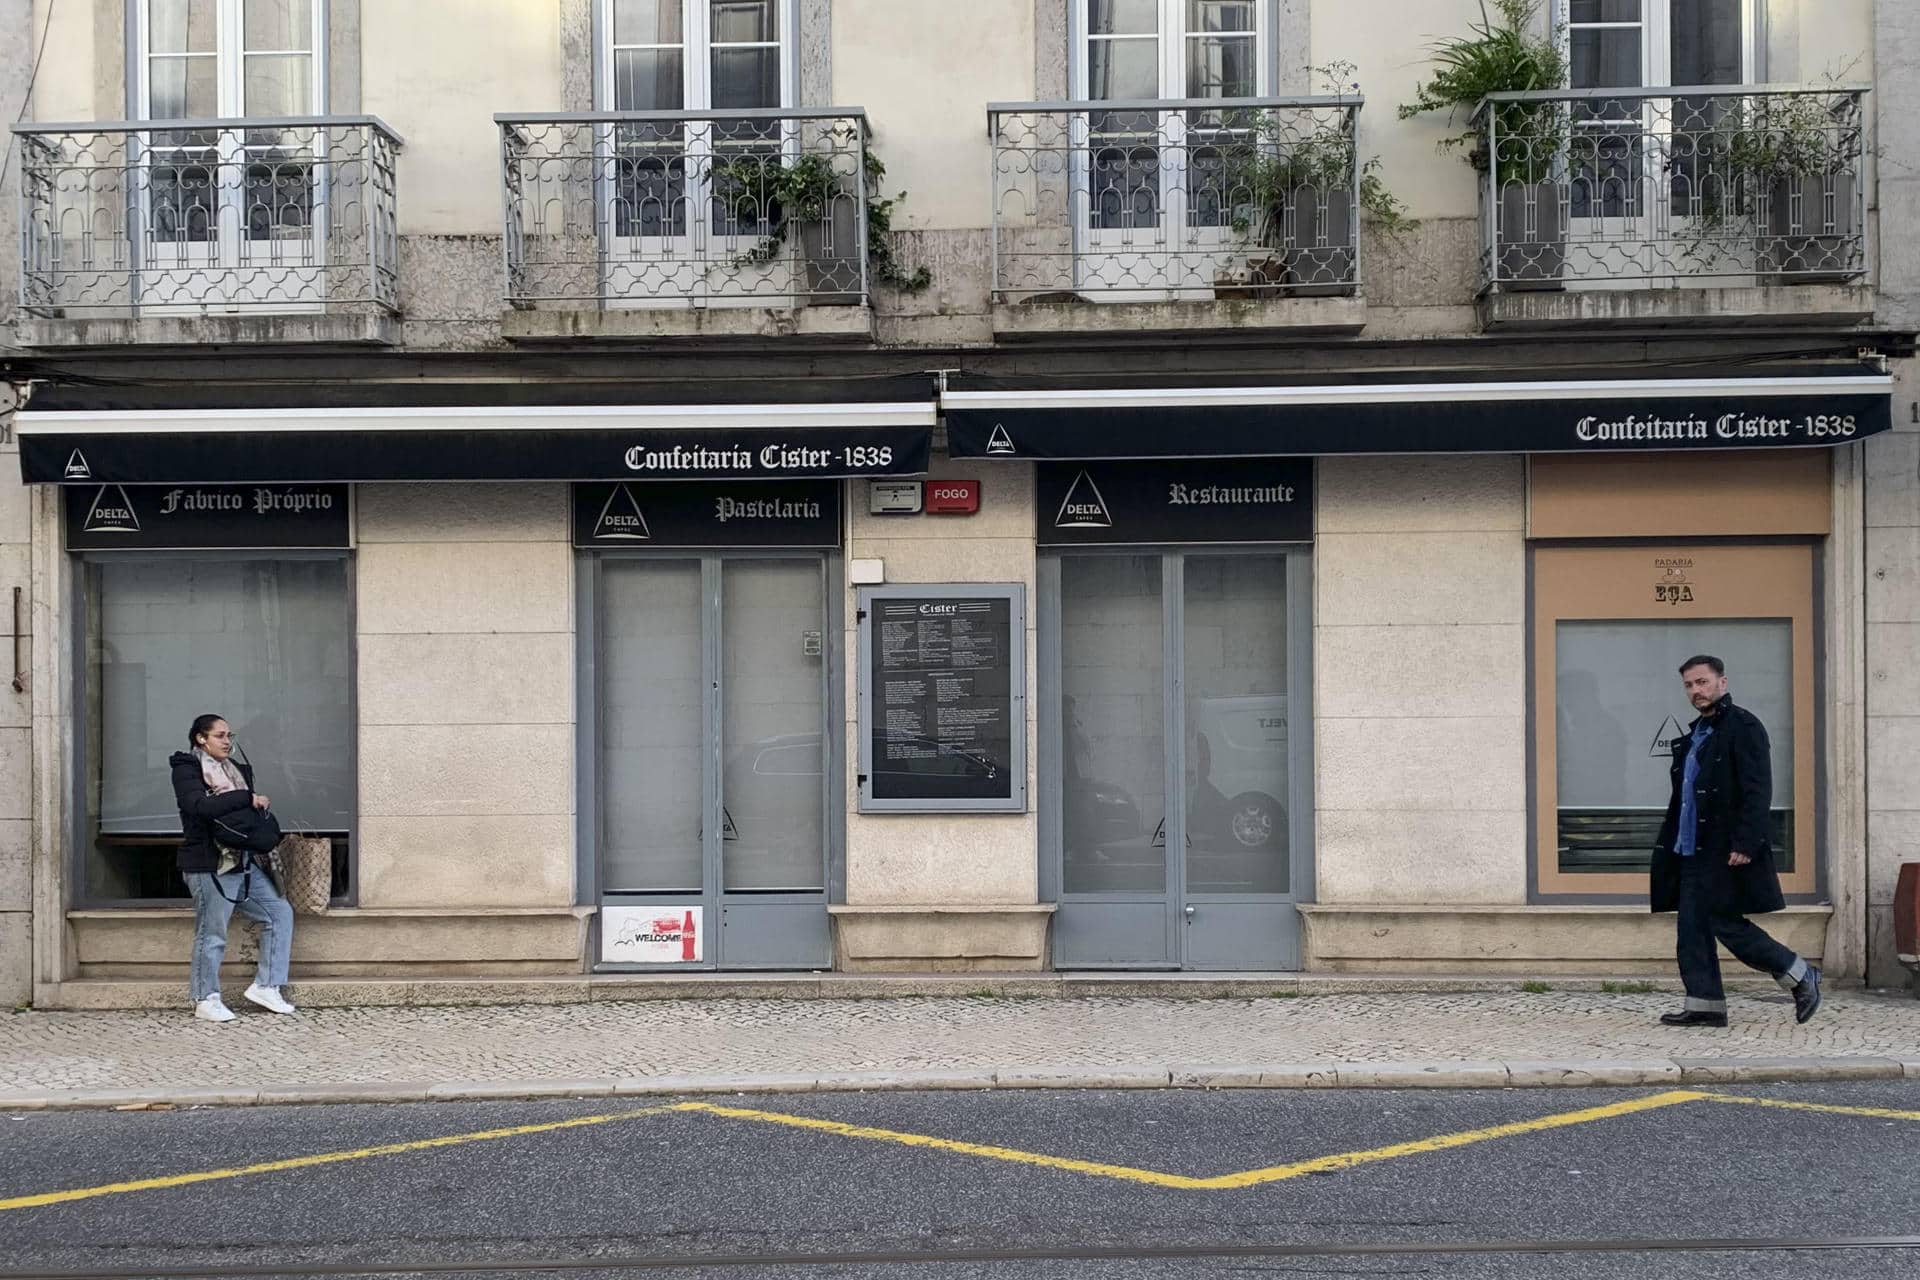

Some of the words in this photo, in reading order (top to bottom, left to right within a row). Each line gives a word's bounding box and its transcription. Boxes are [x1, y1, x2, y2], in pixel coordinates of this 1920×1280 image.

[1576, 413, 1708, 441] Confeitaria
[1715, 412, 1790, 438] Cister
[624, 445, 752, 469] Confeitaria
[759, 444, 832, 469] Cister
[159, 489, 243, 514] Fabrico
[252, 487, 333, 514] Próprio
[934, 488, 969, 499] FOGO
[1167, 482, 1296, 505] Restaurante
[95, 508, 131, 520] DELTA
[714, 496, 821, 522] Pastelaria
[1067, 503, 1103, 515] DELTA
[605, 515, 641, 527] DELTA
[920, 603, 957, 614] Cister
